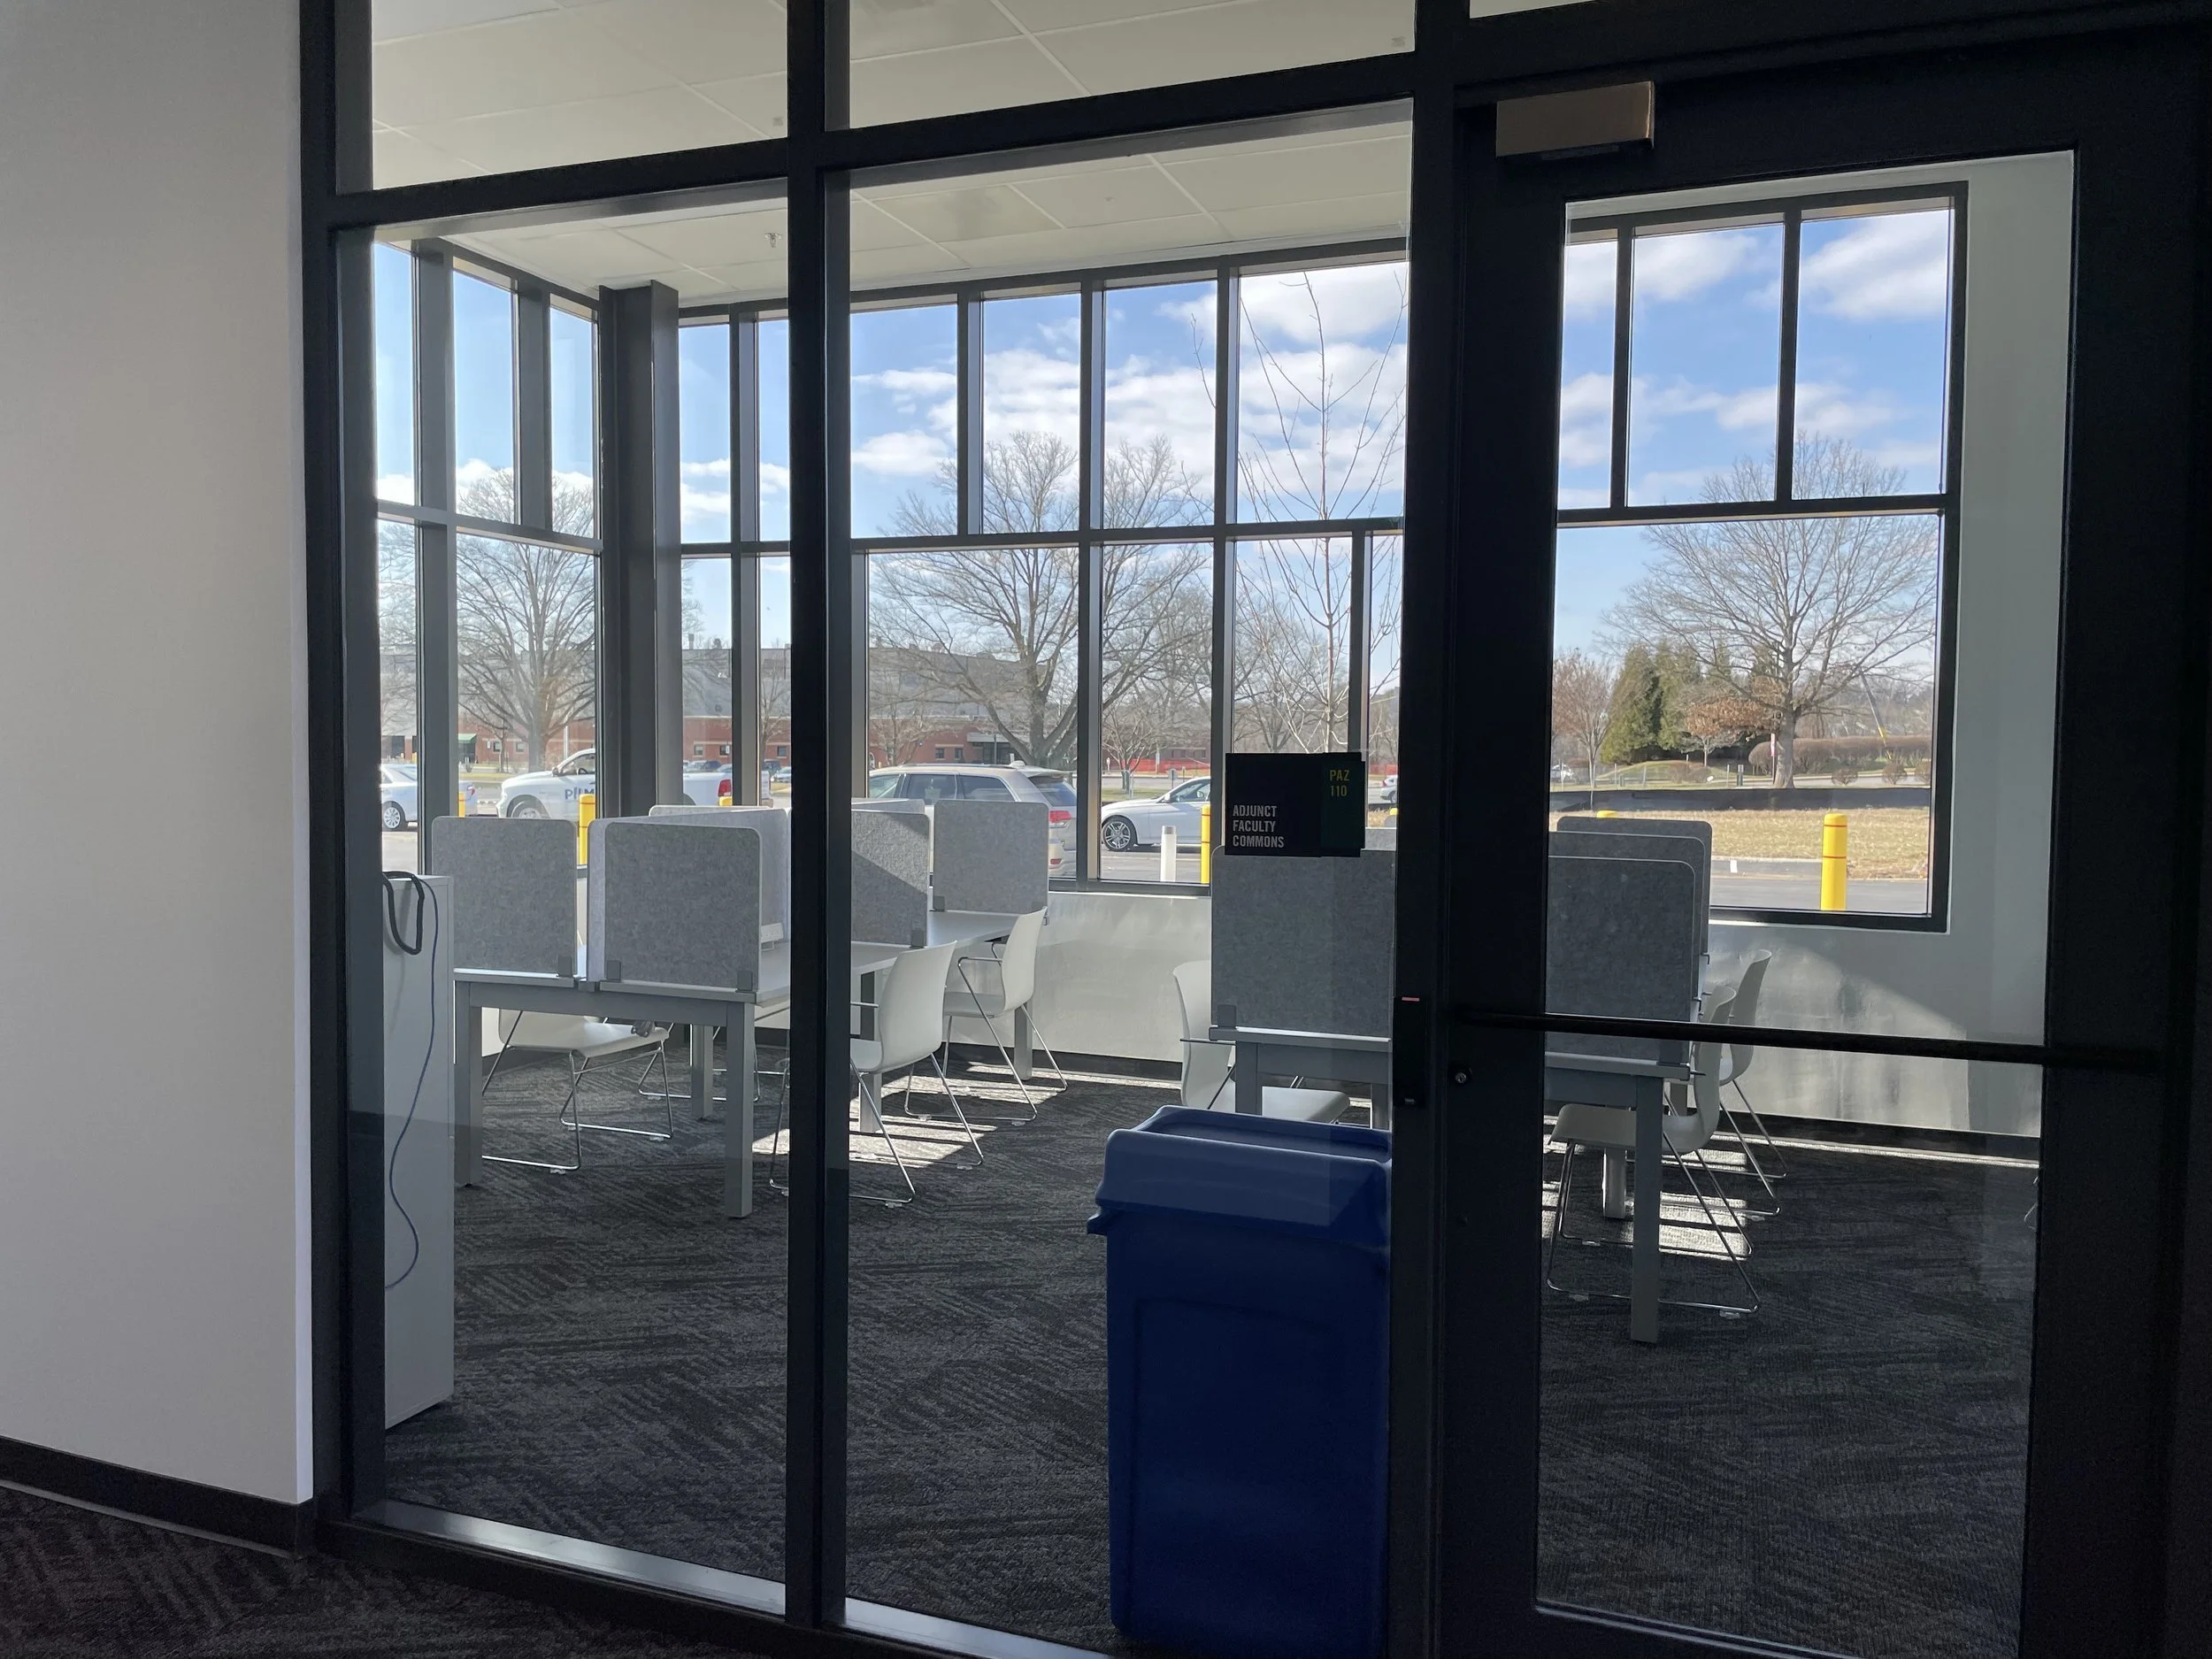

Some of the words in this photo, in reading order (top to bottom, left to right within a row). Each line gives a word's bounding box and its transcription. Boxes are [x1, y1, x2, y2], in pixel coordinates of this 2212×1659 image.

[1330, 769, 1350, 781] PAZ
[1331, 785, 1348, 797] 110
[1233, 804, 1278, 818] ADJUNCT
[1233, 819, 1276, 833] FACULTY
[1233, 834, 1285, 849] COMMONS
